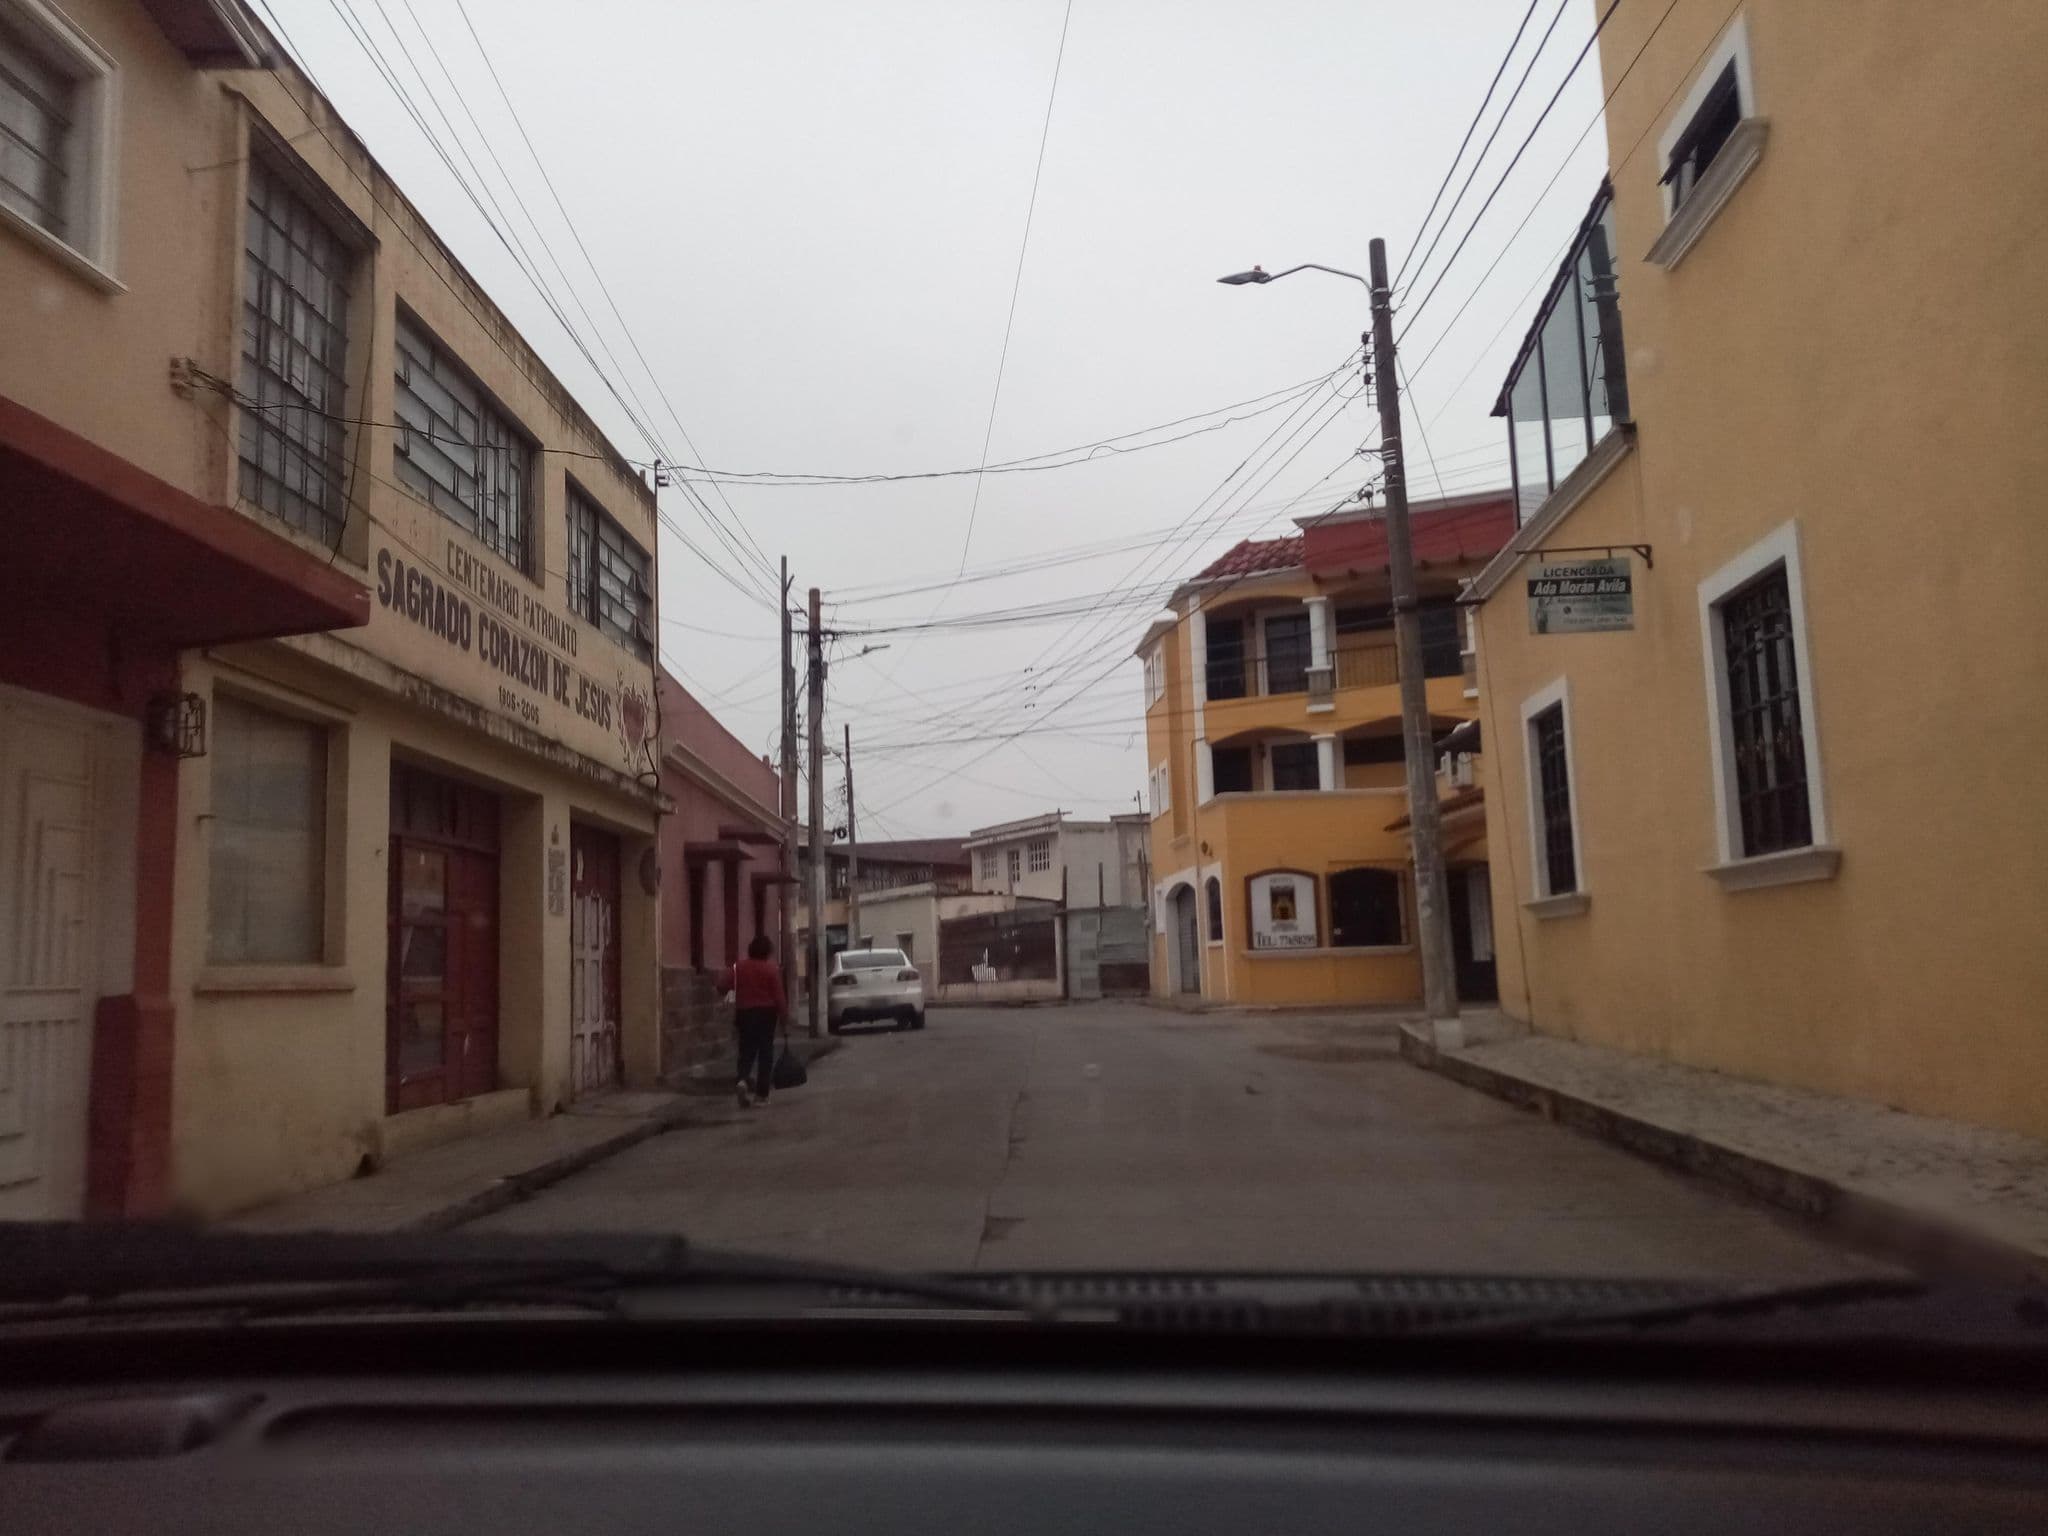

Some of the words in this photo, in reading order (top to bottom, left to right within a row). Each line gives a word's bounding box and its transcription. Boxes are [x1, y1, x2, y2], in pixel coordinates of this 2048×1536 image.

[447, 539, 519, 619] CENTENARIO
[523, 594, 577, 657] PATRONATO
[1534, 581, 1557, 595] Ada
[1544, 566, 1614, 577] LICENCIADA
[377, 547, 471, 651] SAGRADO
[478, 612, 548, 695] CORAZON
[553, 658, 570, 707] DE
[575, 674, 611, 731] JESUS
